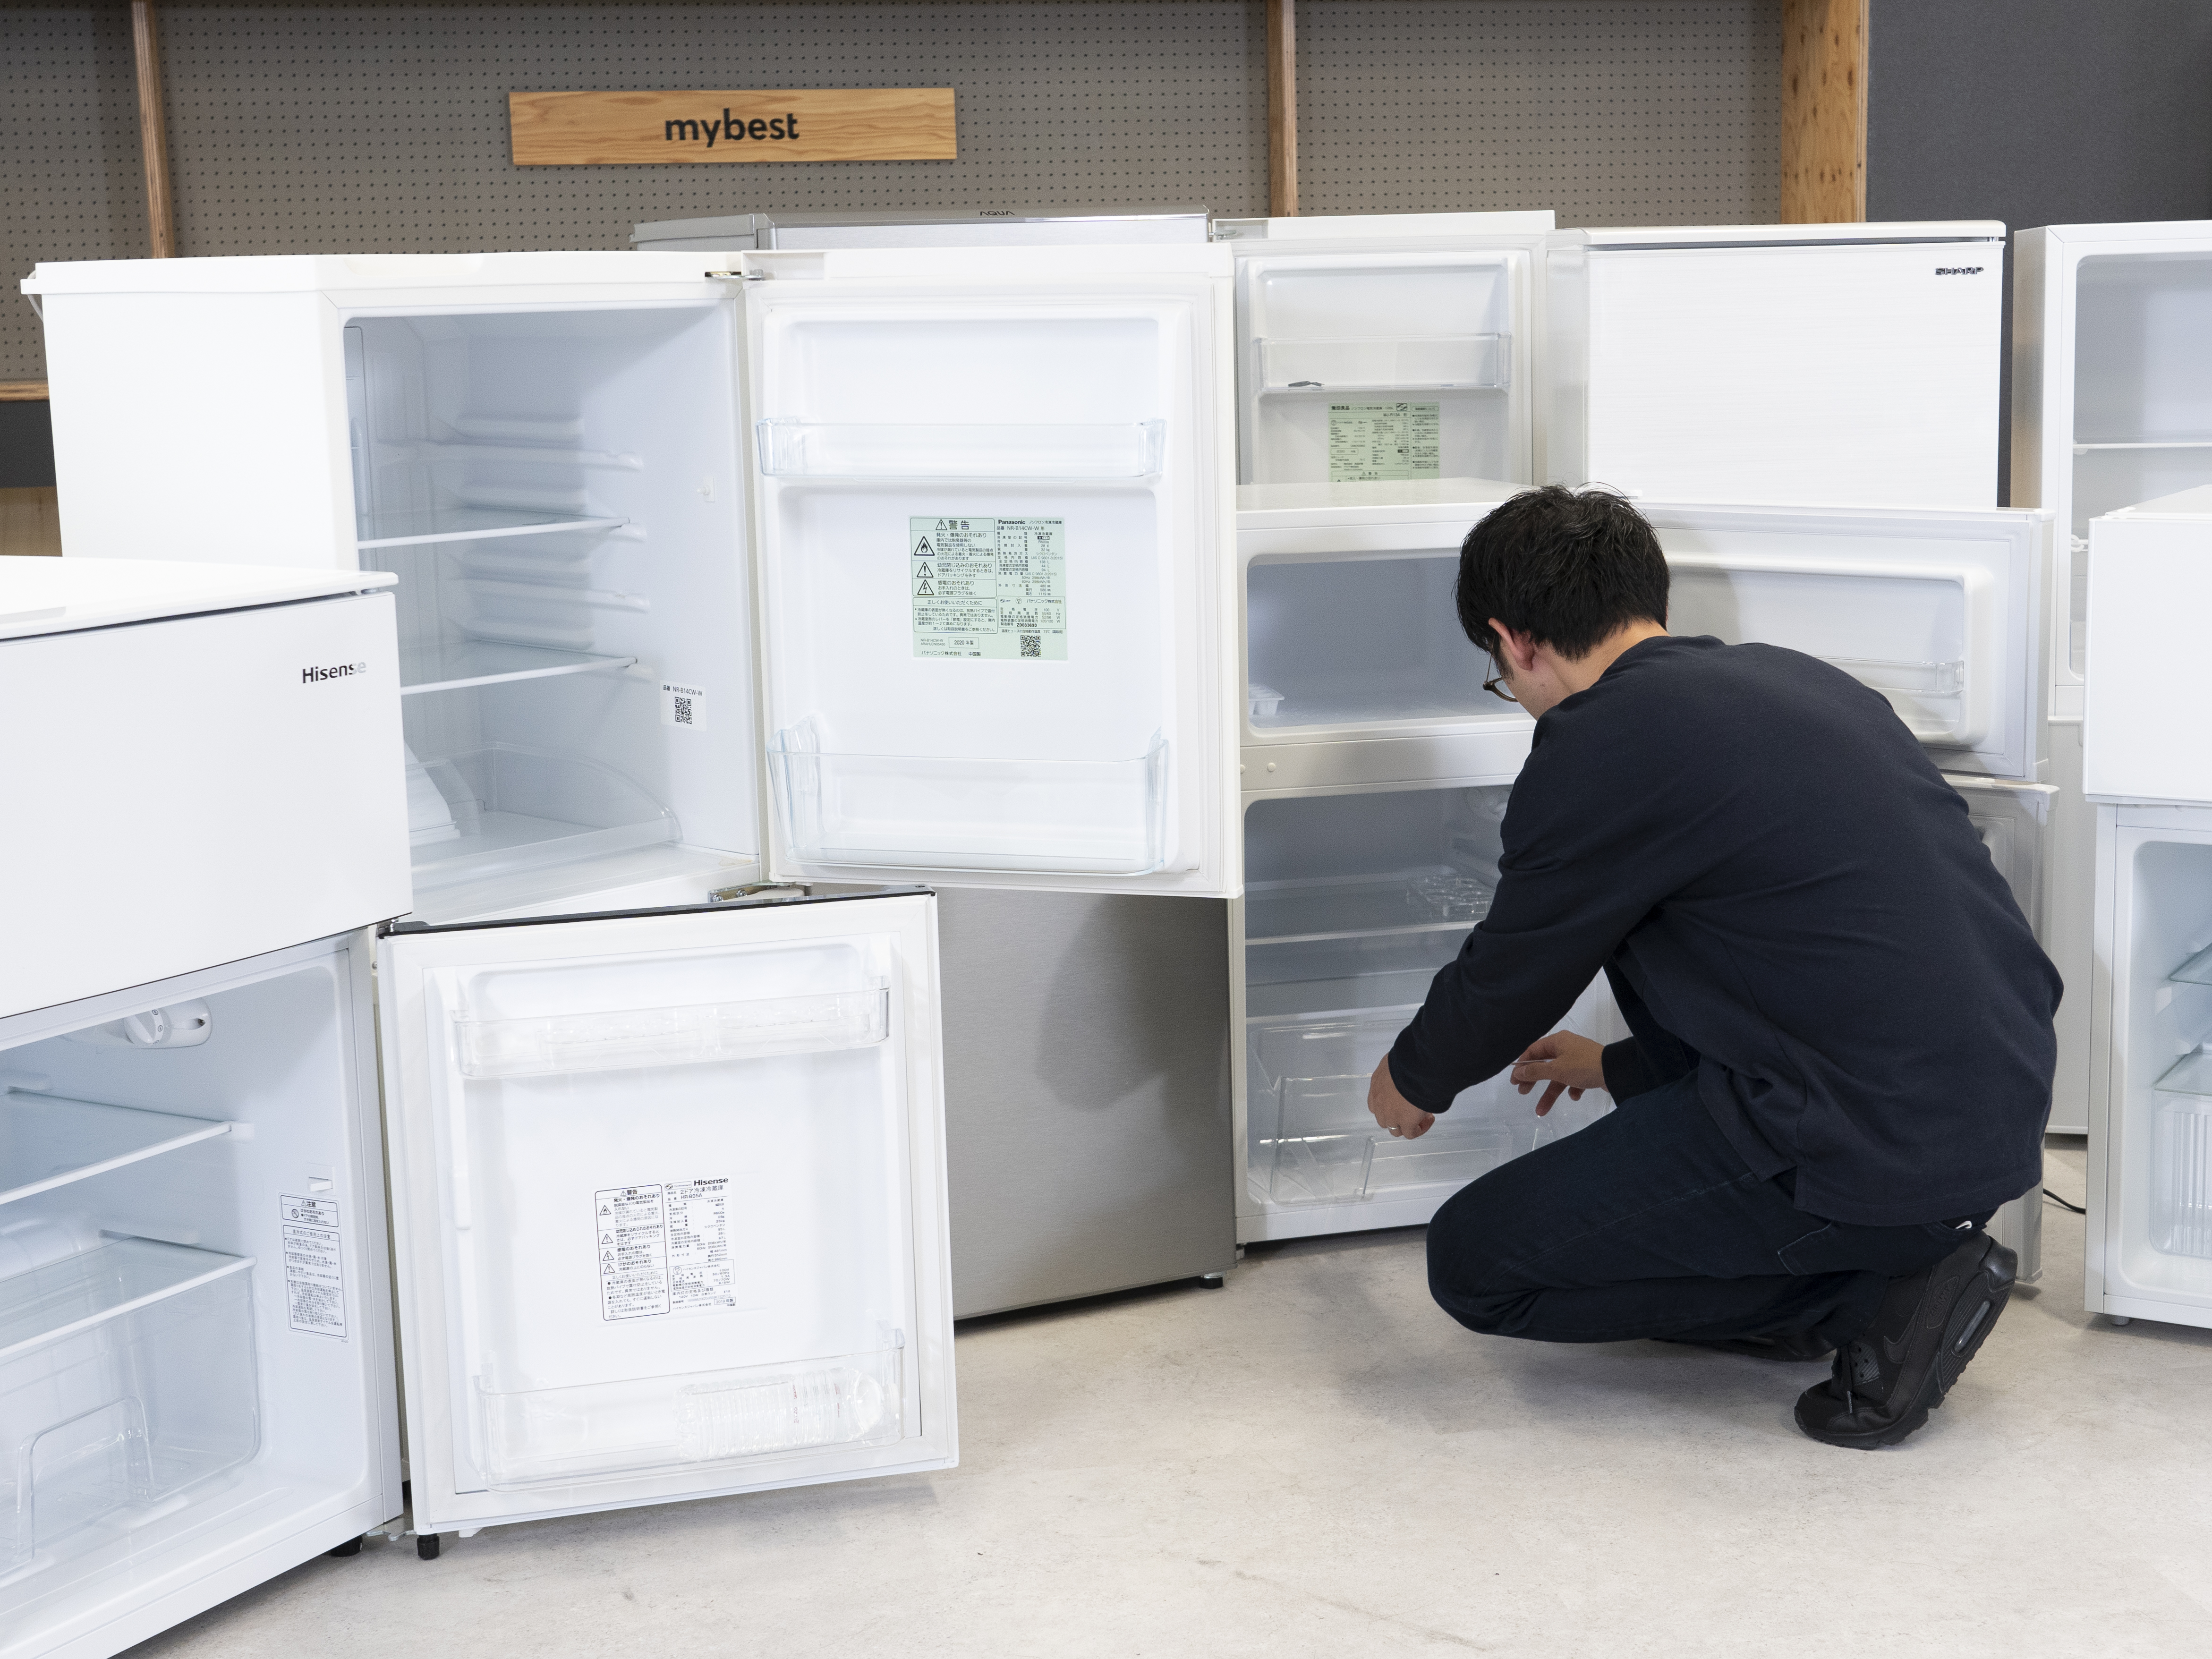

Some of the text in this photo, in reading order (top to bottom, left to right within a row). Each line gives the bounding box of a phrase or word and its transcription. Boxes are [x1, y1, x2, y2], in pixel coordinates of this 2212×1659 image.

[665, 108, 800, 148] mybest
[1935, 267, 1984, 275] SHARP
[949, 520, 970, 530] 警告
[303, 662, 366, 683] Hisense
[673, 686, 702, 696] NR-B14CW-W
[681, 1185, 723, 1194] 2ドア冷凍冷蔵庫
[614, 1194, 660, 1202] 発火・爆発のおそれあり
